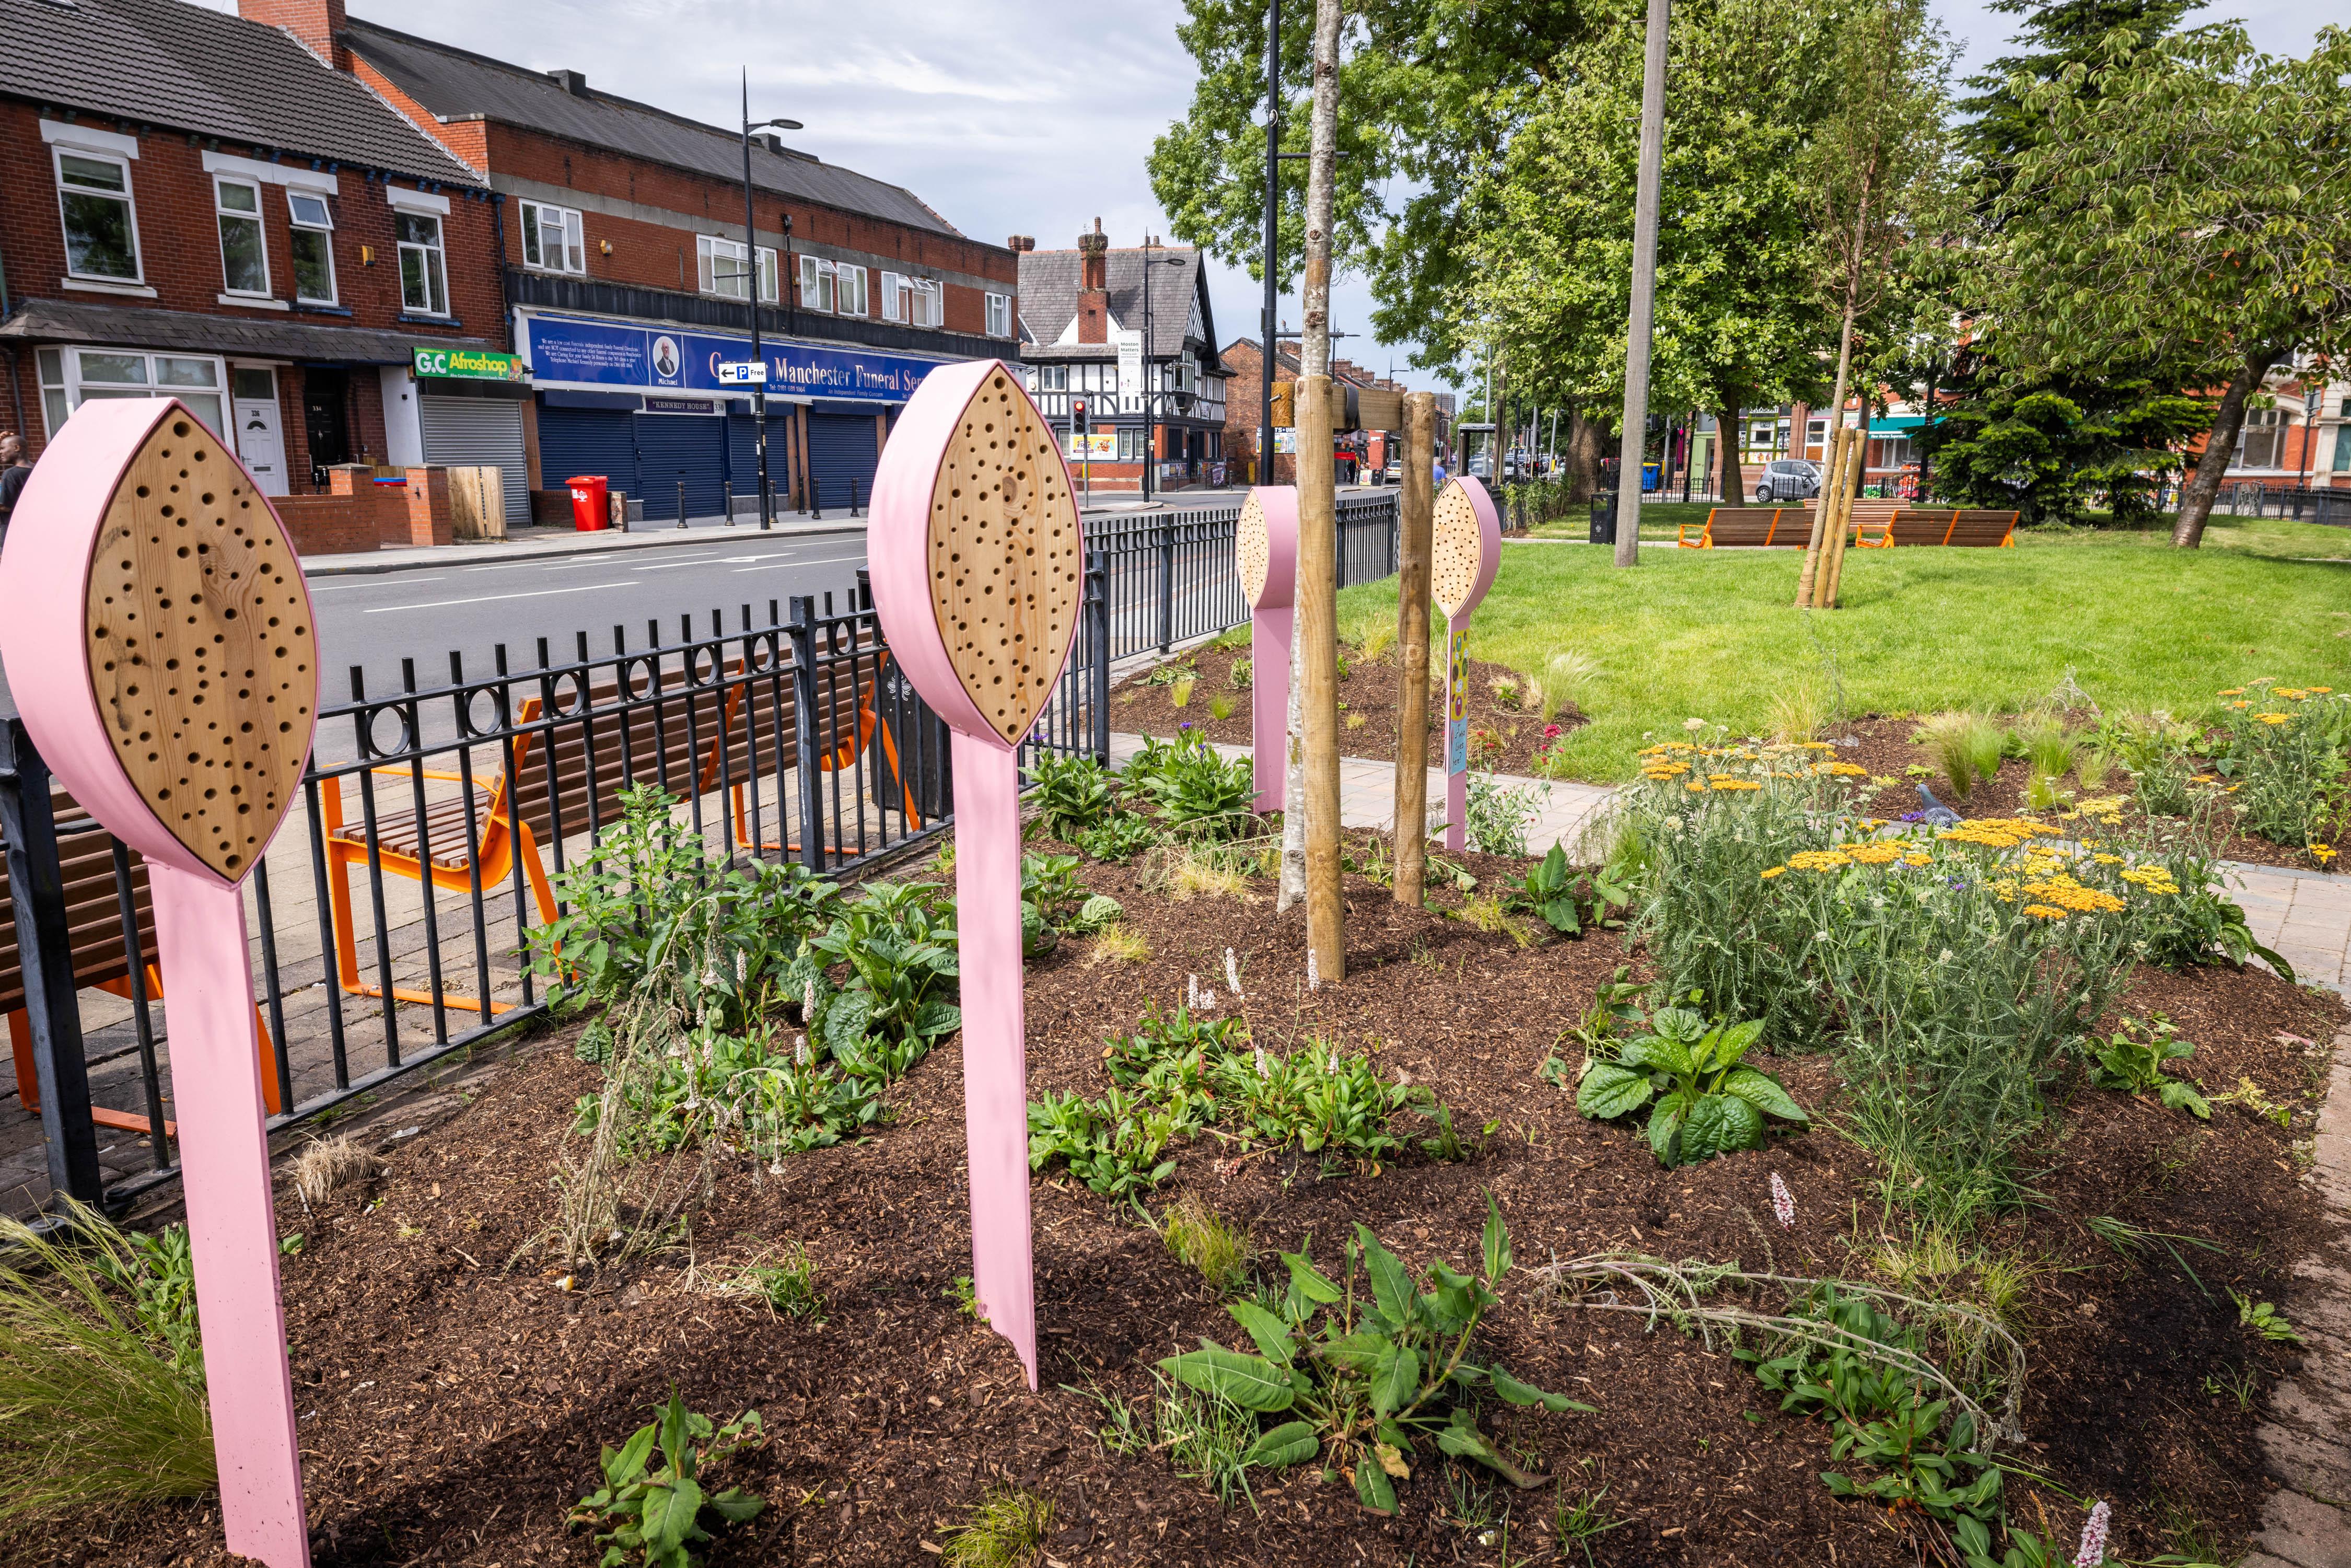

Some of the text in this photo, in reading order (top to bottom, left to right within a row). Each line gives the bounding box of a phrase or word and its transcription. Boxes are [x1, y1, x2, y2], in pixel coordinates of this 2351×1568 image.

[449, 352, 507, 376] Afroshop
[739, 368, 747, 379] P
[774, 357, 851, 386] Manchester
[855, 365, 899, 390] Funeral
[904, 369, 925, 391] Ser
[1455, 742, 1464, 752] lives
